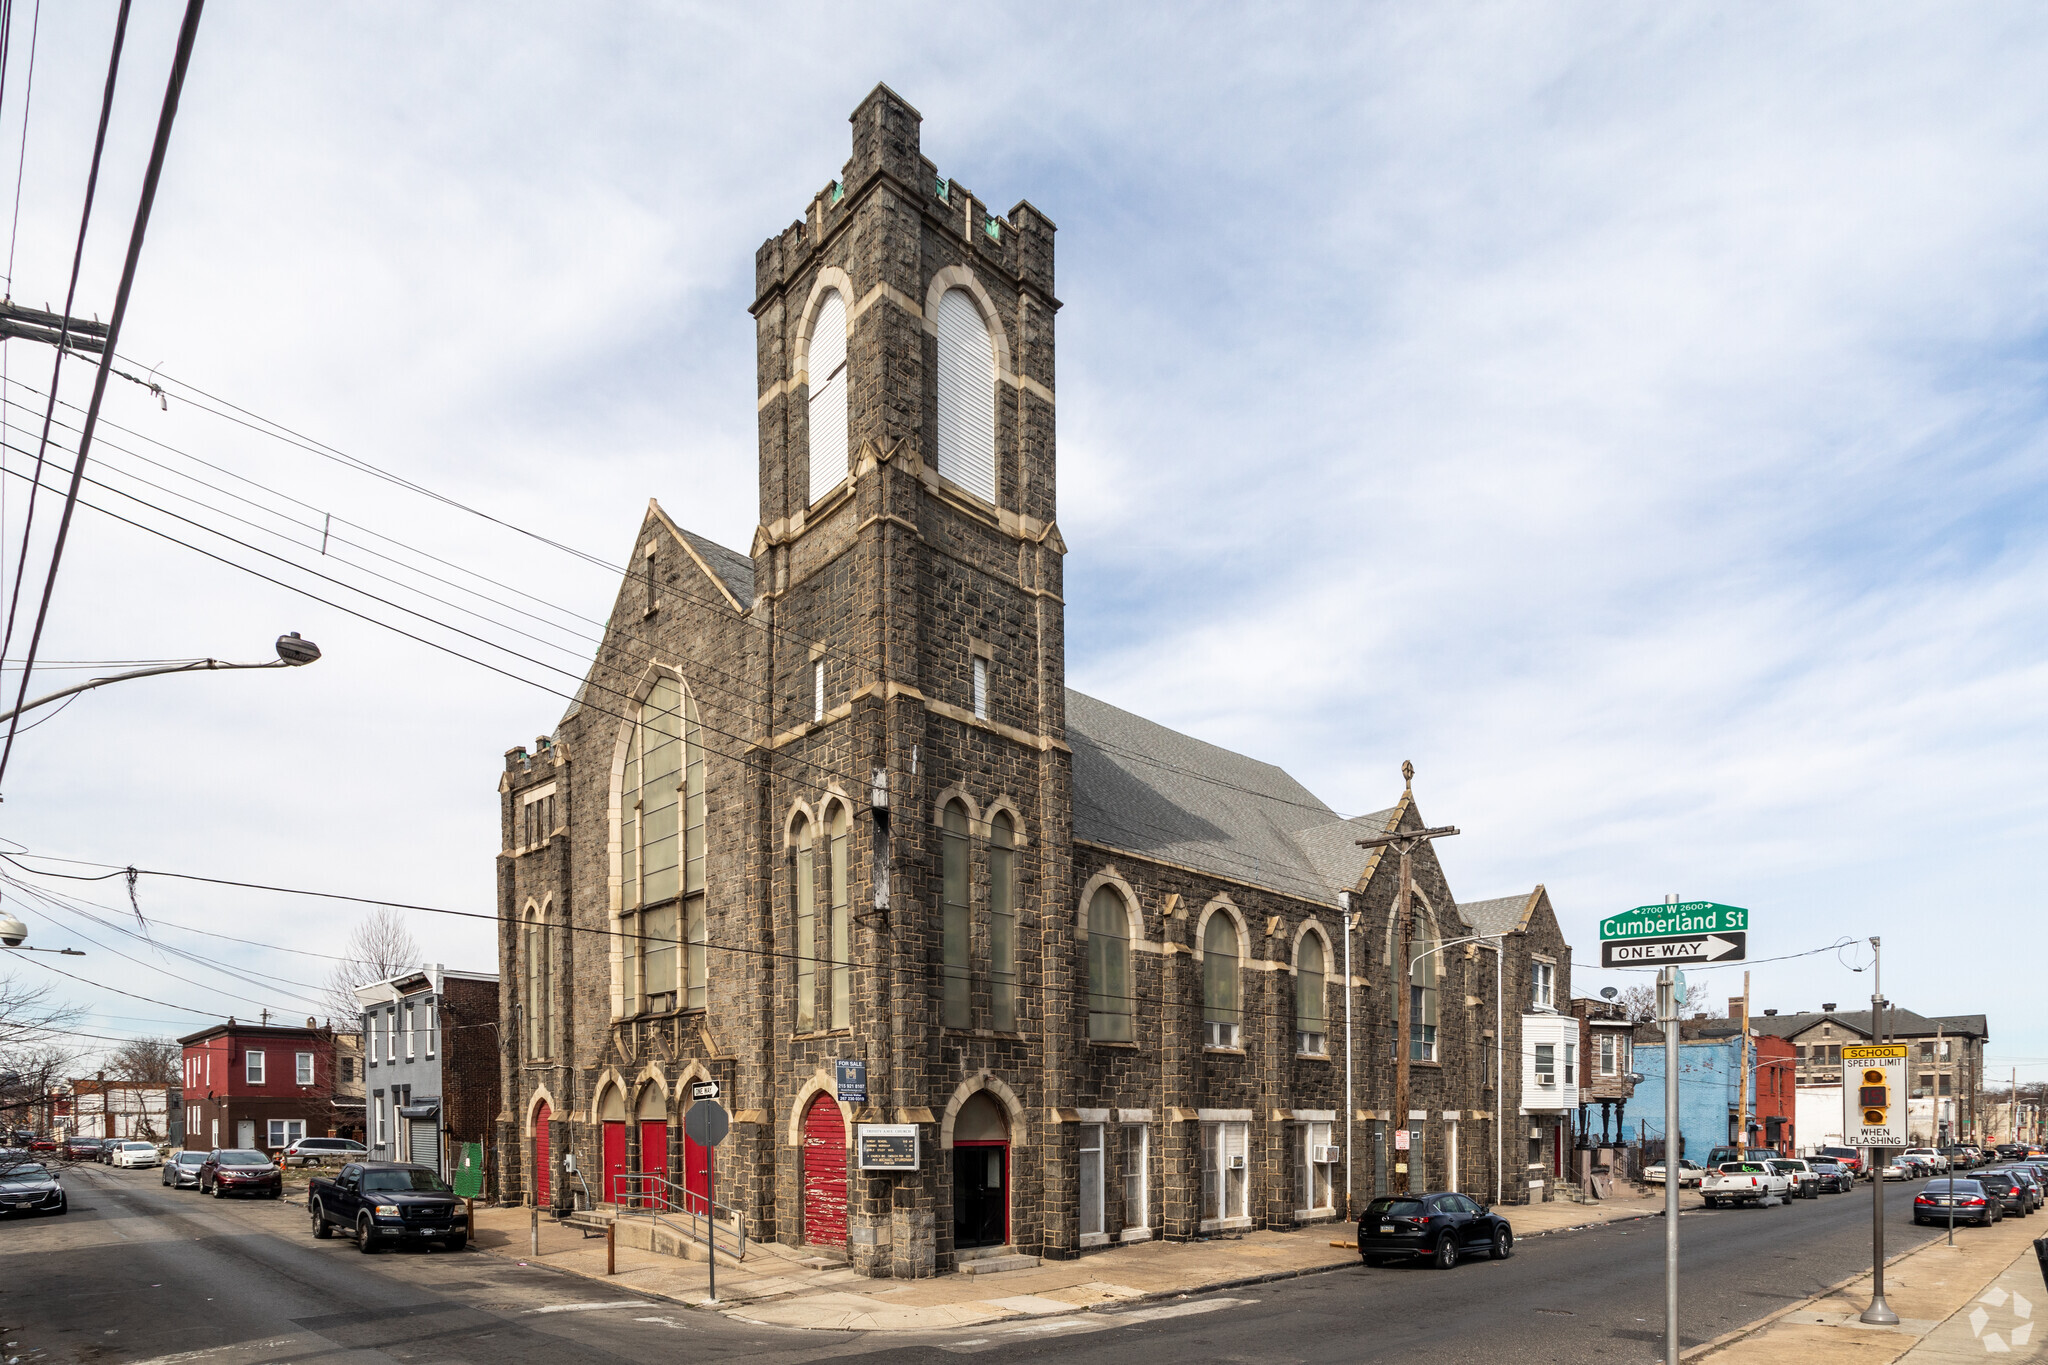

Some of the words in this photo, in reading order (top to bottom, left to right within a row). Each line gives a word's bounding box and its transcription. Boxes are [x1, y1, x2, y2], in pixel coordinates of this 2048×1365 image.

[1641, 906, 1663, 914] 2700
[1666, 904, 1678, 914] W
[1680, 903, 1704, 912] 2600
[1604, 912, 1716, 936] Cumberland
[1725, 911, 1744, 927] St
[1618, 946, 1655, 959] ONE
[1662, 943, 1702, 956] WAY
[1850, 1049, 1898, 1057] SCHOOL
[1864, 1089, 1883, 1104] 15
